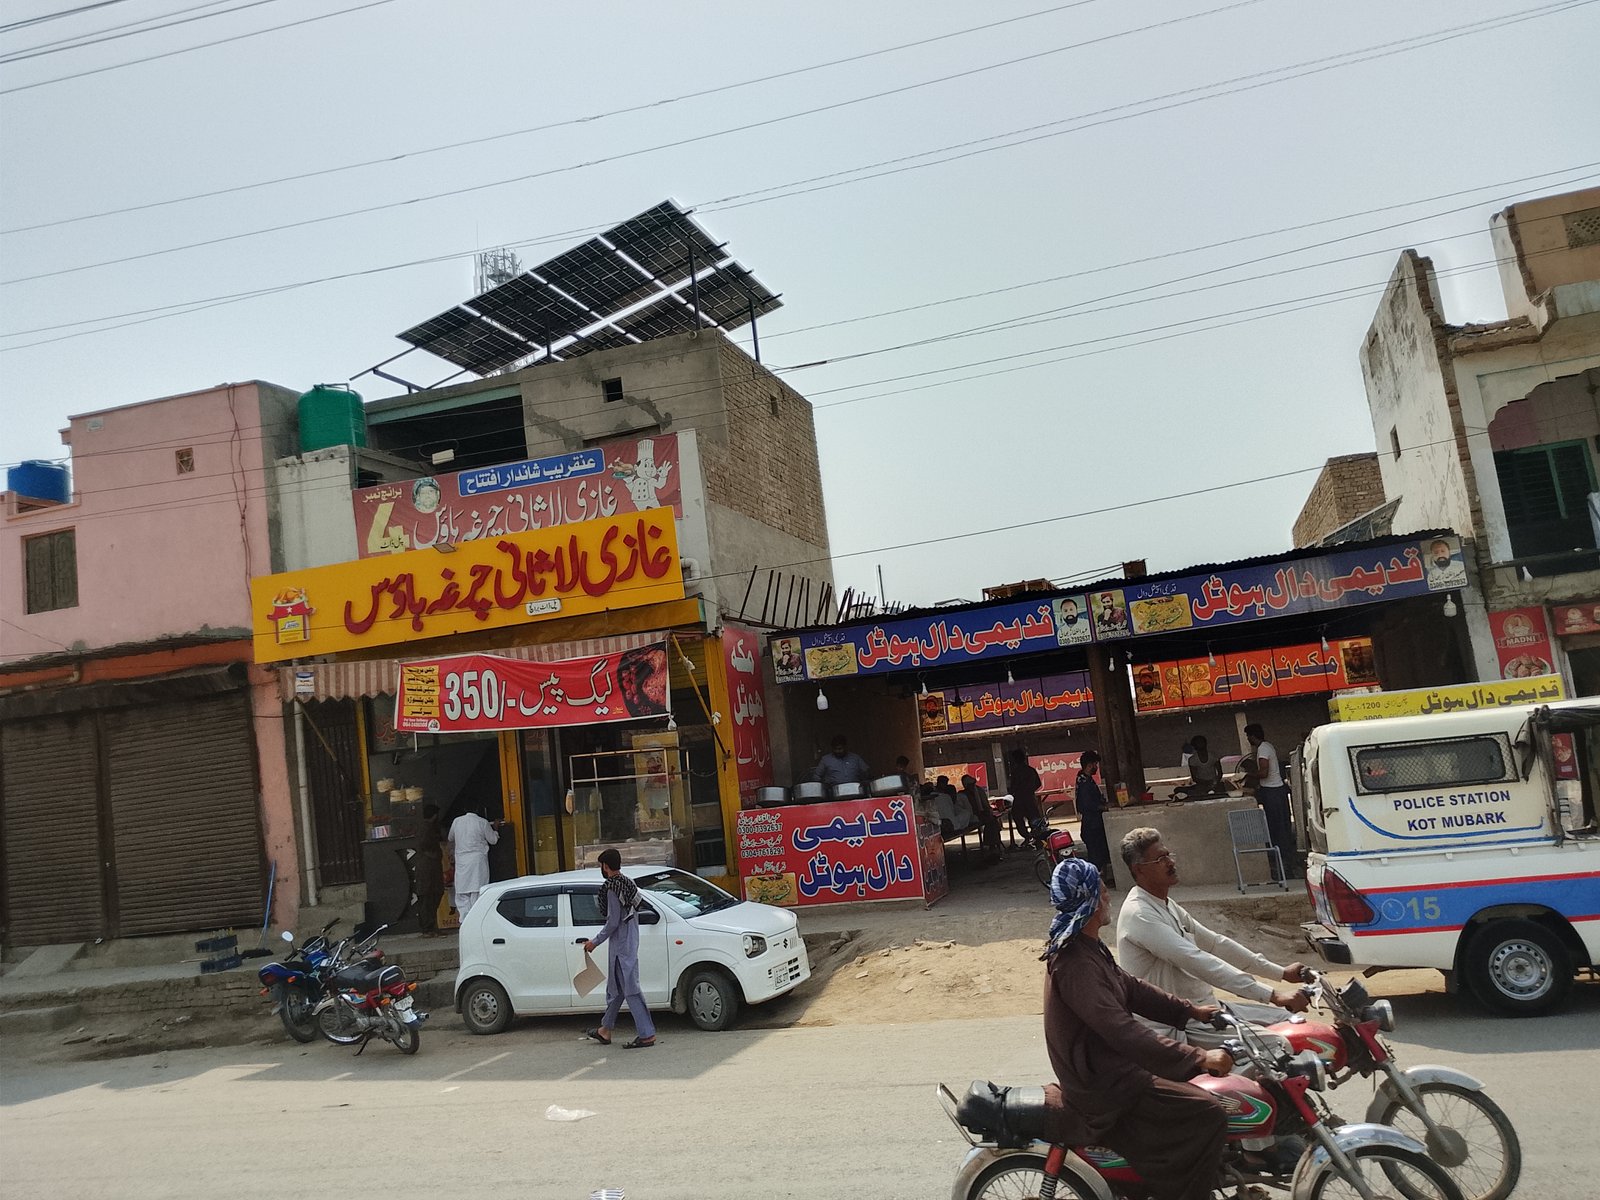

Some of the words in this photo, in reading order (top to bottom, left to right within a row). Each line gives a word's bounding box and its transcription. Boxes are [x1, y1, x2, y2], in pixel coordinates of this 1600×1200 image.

[466, 473, 502, 494] افتتاح
[504, 463, 542, 487] شاندار
[543, 456, 596, 478] عنقریب
[566, 480, 619, 524] غازی
[367, 501, 410, 555] 4
[581, 518, 672, 597] غازی
[1318, 545, 1425, 601] قدیمی
[426, 564, 493, 622] چرغہ
[1192, 574, 1267, 621] ہوٹل
[1267, 565, 1316, 610] دال
[858, 625, 922, 668] ہوٹل
[921, 620, 965, 660] دال
[964, 603, 1055, 654] قدیمی
[1506, 635, 1536, 645] MADNI
[1214, 659, 1260, 695] والے
[1260, 655, 1293, 688] نان
[1293, 650, 1340, 677] مکہ
[519, 671, 564, 716] پیس
[565, 658, 613, 715] لیگ
[974, 692, 1015, 719] ہوٹل
[1015, 689, 1044, 713] دال
[1466, 688, 1495, 710] دال
[1498, 680, 1560, 706] قدیمی
[1362, 702, 1381, 710] 1200
[1393, 796, 1445, 811] POLICE
[1449, 790, 1511, 806] STATION
[792, 799, 909, 851] قدیمی
[1407, 817, 1437, 831] KOT
[1442, 812, 1507, 828] MUBARK
[799, 852, 866, 896] ہوٹل
[867, 849, 914, 891] دال
[1406, 896, 1441, 921] 15
